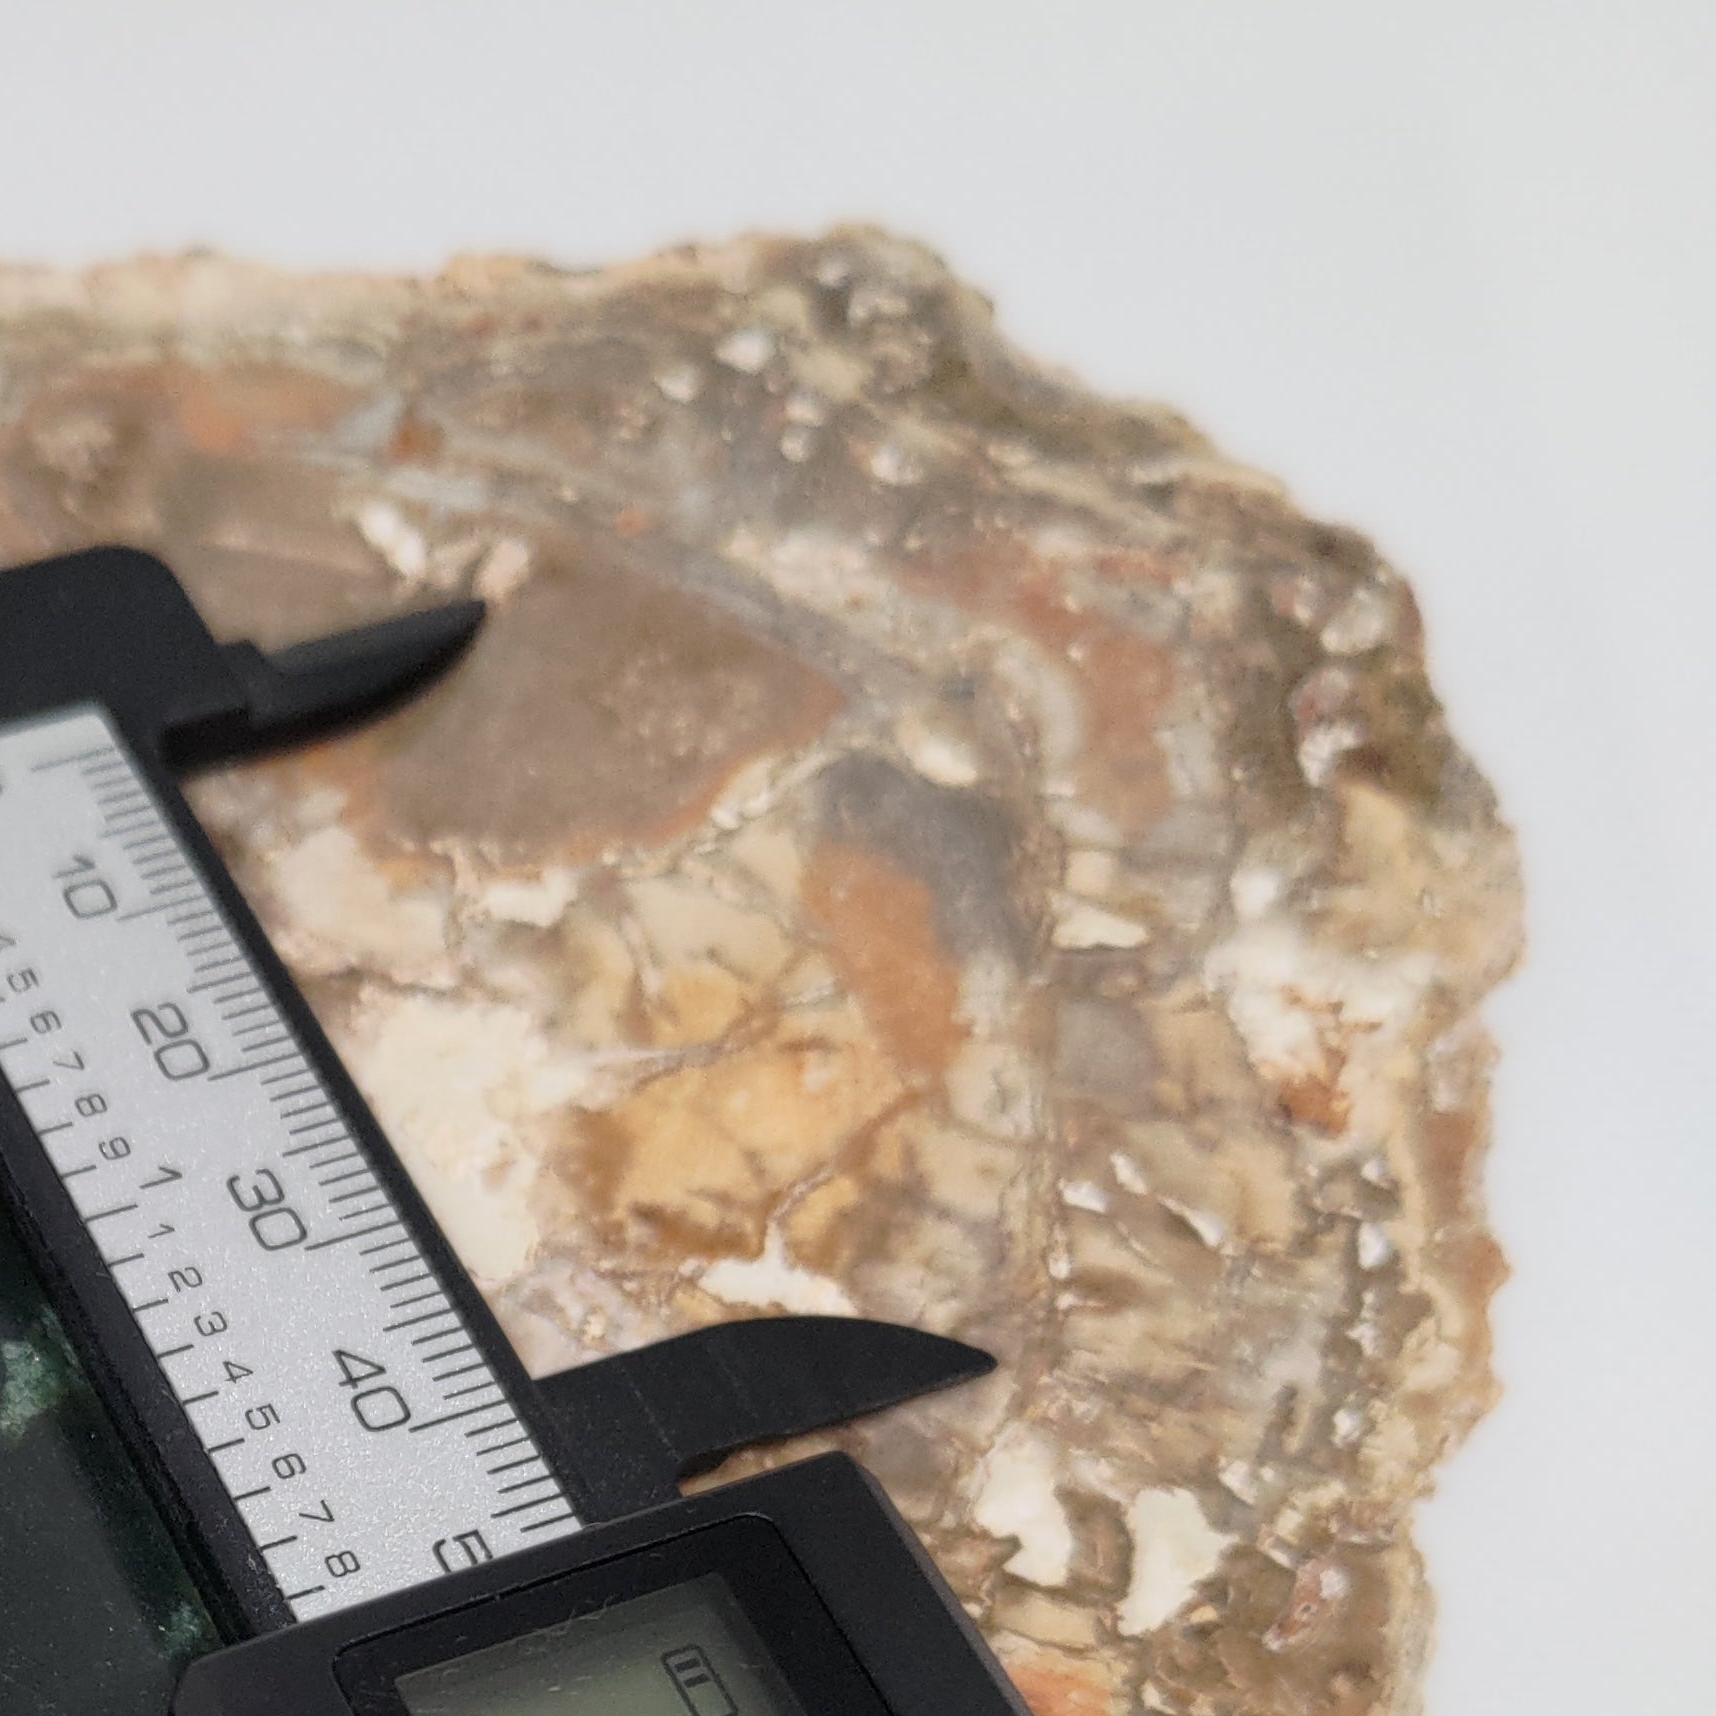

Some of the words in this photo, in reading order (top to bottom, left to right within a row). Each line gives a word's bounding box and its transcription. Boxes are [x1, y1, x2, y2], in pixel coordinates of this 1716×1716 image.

[52, 854, 119, 920] 10
[6, 968, 39, 994] 5
[30, 1009, 62, 1035] 6
[132, 1001, 211, 1082] 20
[53, 1051, 85, 1072] 7
[75, 1093, 108, 1118] 8
[98, 1136, 131, 1161] 9
[140, 1166, 182, 1190] 1
[227, 1168, 308, 1252] 30
[148, 1222, 175, 1239] 1
[168, 1266, 202, 1292] 2
[194, 1310, 228, 1337] 3
[224, 1360, 255, 1383] 4
[332, 1349, 412, 1433] 40
[245, 1403, 281, 1431] 5
[272, 1453, 307, 1480] 6
[299, 1500, 335, 1523] 7
[324, 1550, 362, 1578] 8
